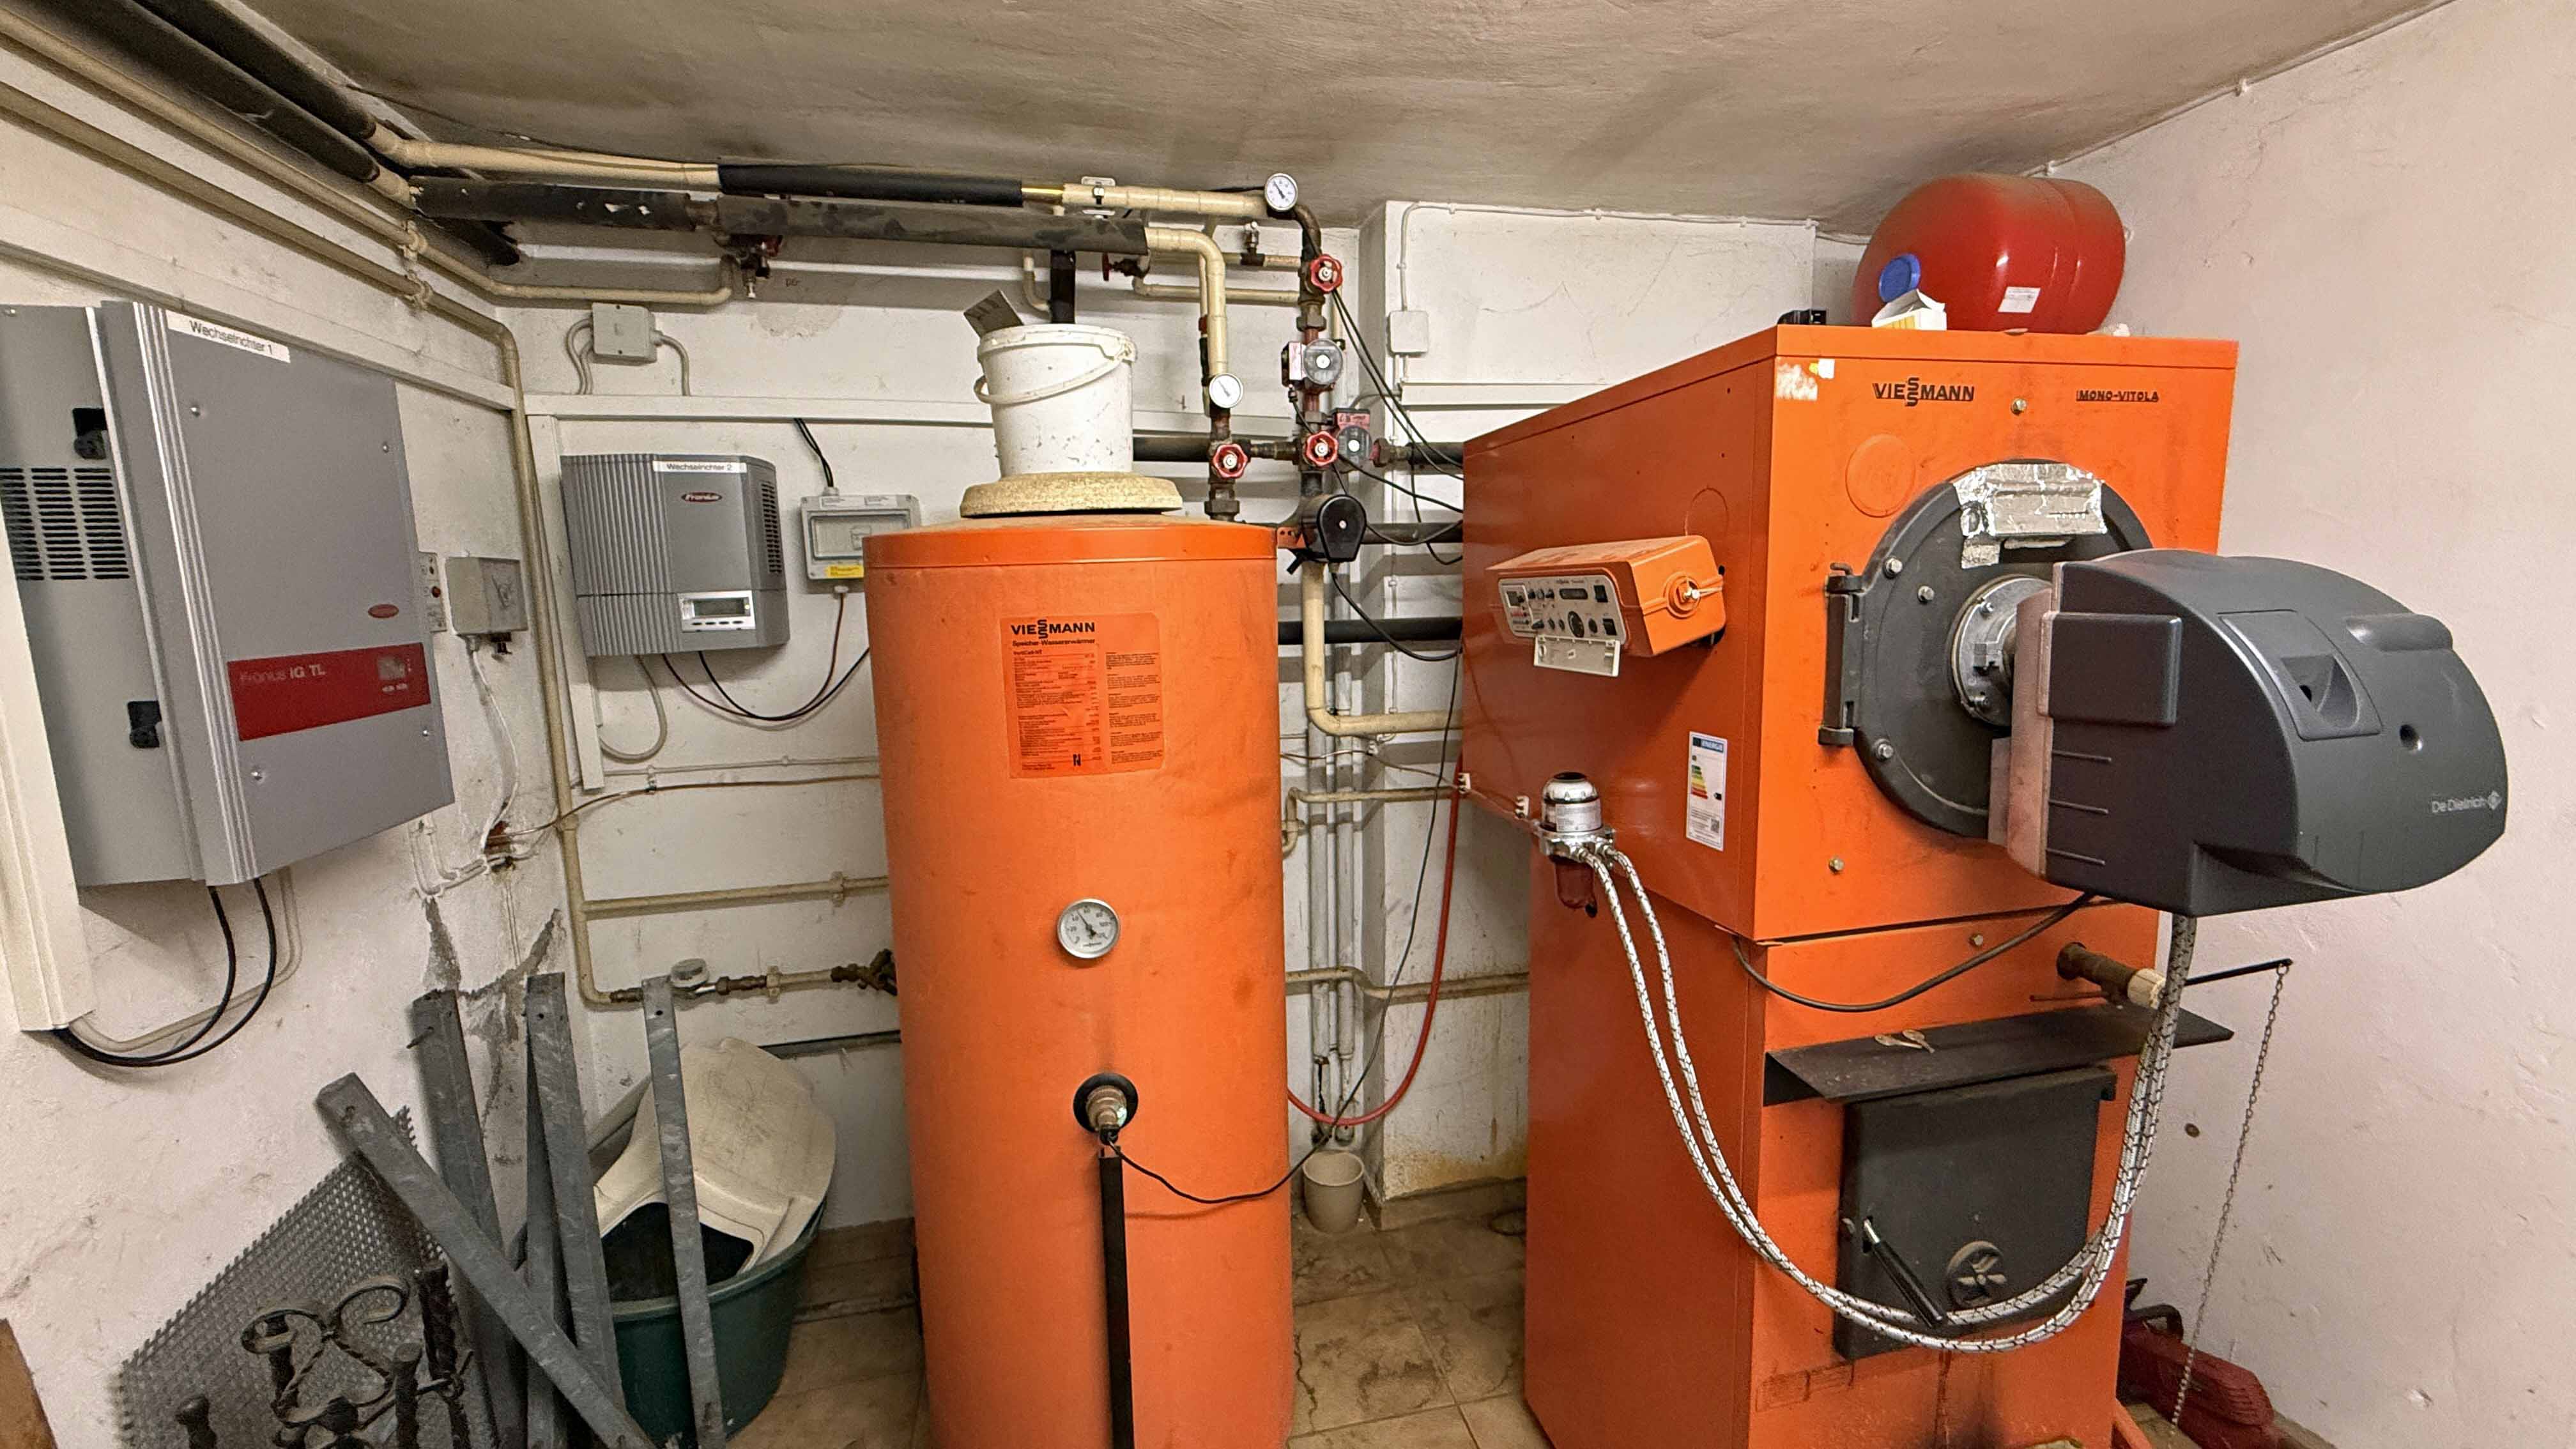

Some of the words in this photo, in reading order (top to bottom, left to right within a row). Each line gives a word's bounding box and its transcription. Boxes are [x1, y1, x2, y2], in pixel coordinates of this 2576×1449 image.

[190, 320, 264, 351] Wechselrichter
[267, 344, 273, 355] 1
[1872, 377, 1975, 407] VIESSMANN
[2076, 389, 2159, 402] MONO-VITOLA
[1011, 619, 1095, 639] VIESSMANN
[289, 664, 305, 679] IG
[309, 663, 326, 677] TL
[2432, 801, 2446, 813] De
[2448, 796, 2487, 811] Dietrich
